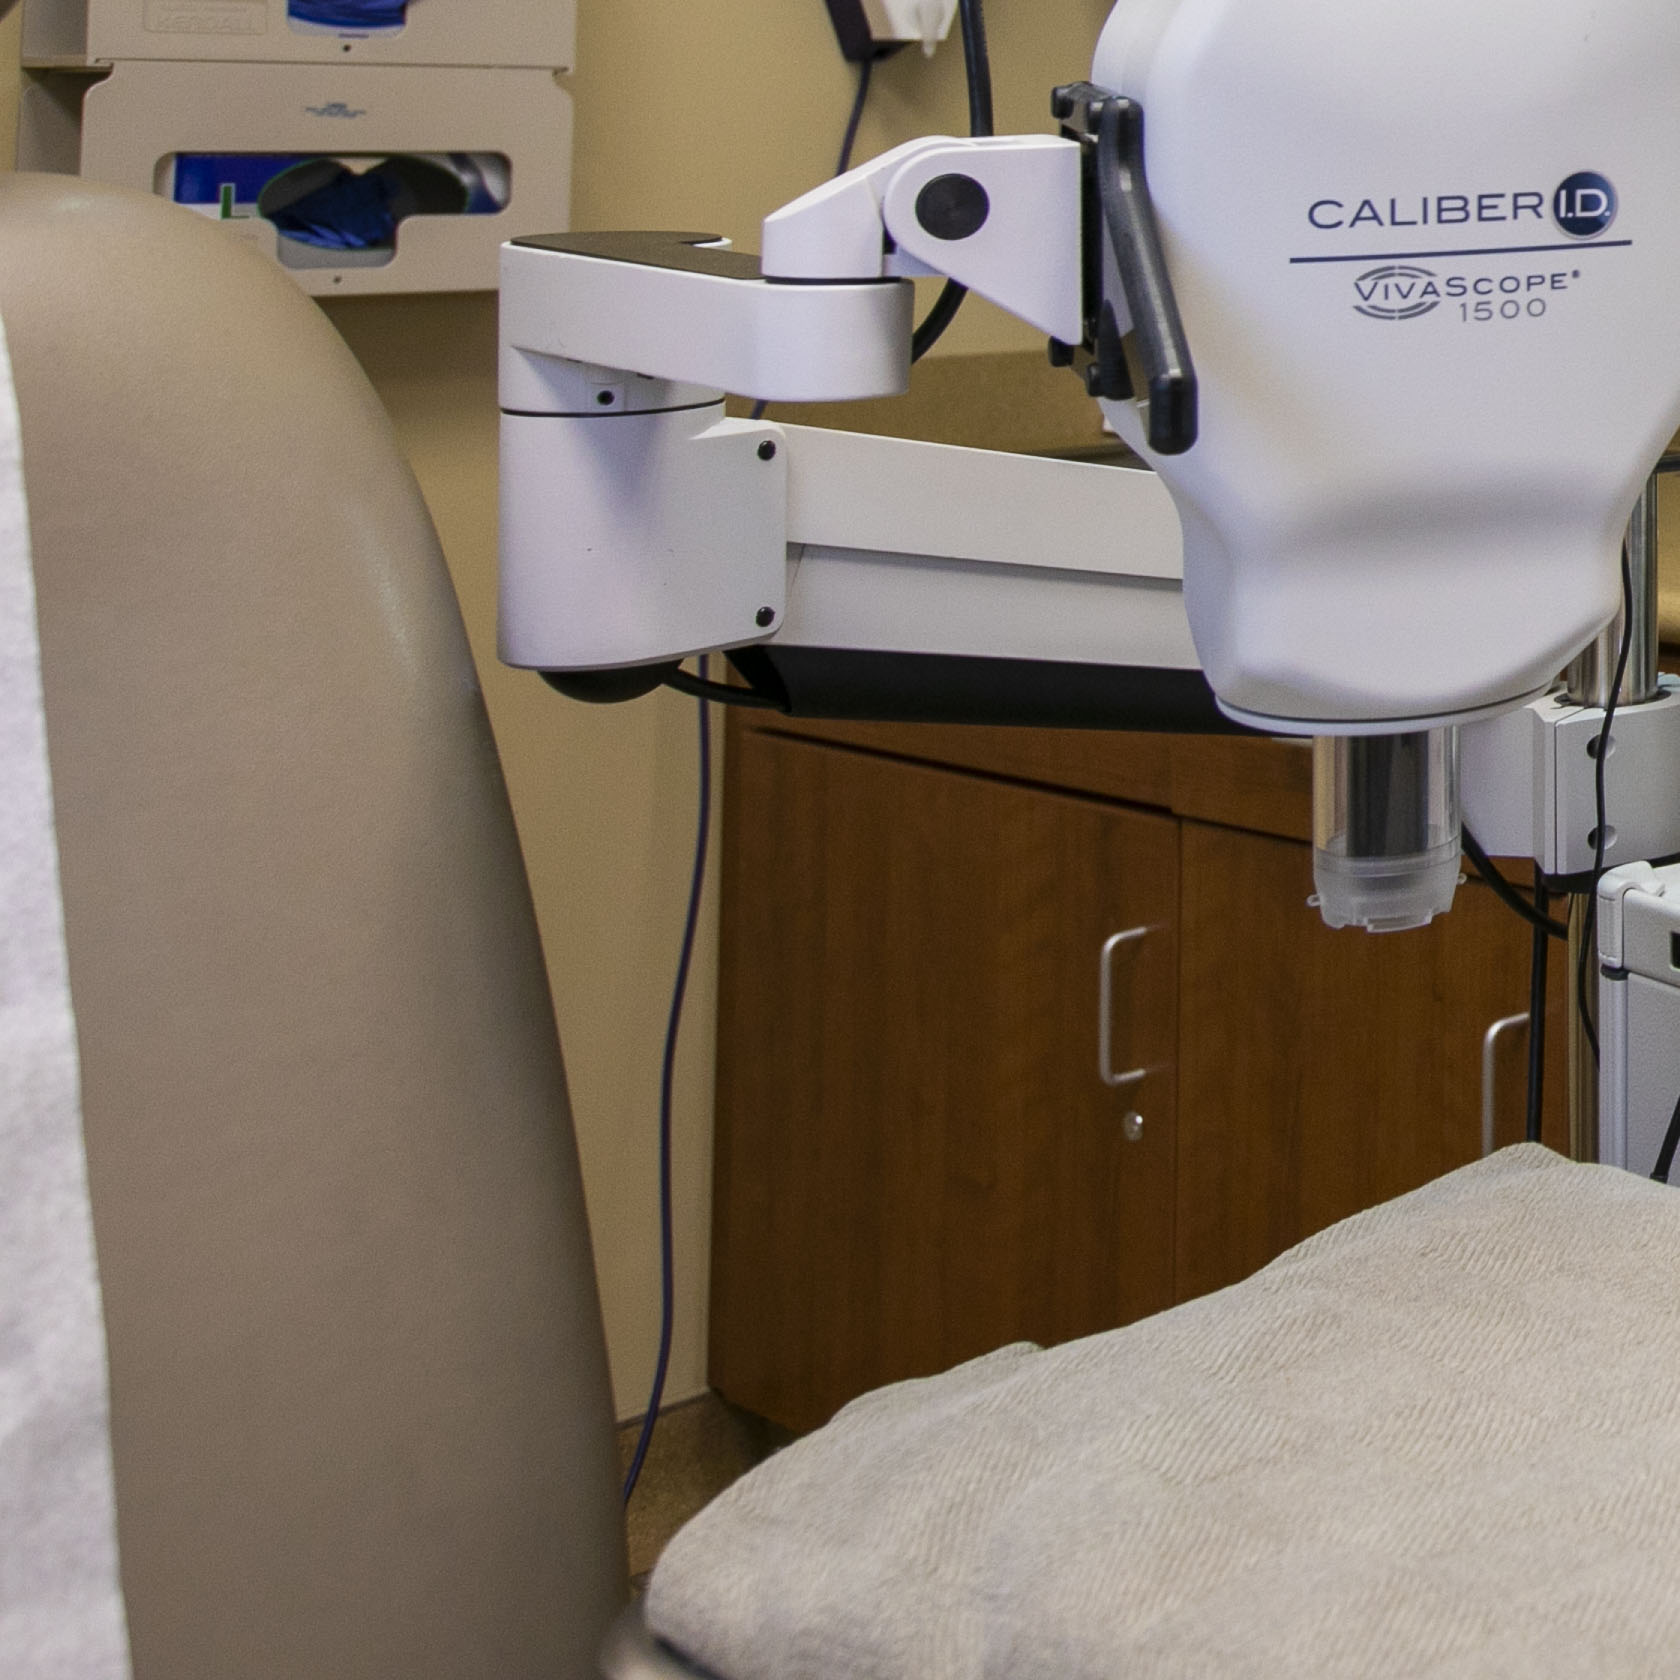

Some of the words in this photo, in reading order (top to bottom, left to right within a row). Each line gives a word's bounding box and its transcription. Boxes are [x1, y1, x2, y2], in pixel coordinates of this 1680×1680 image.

[1308, 191, 1544, 229] CALIBER
[1558, 188, 1611, 219] I.D.
[1460, 298, 1547, 323] 1500
